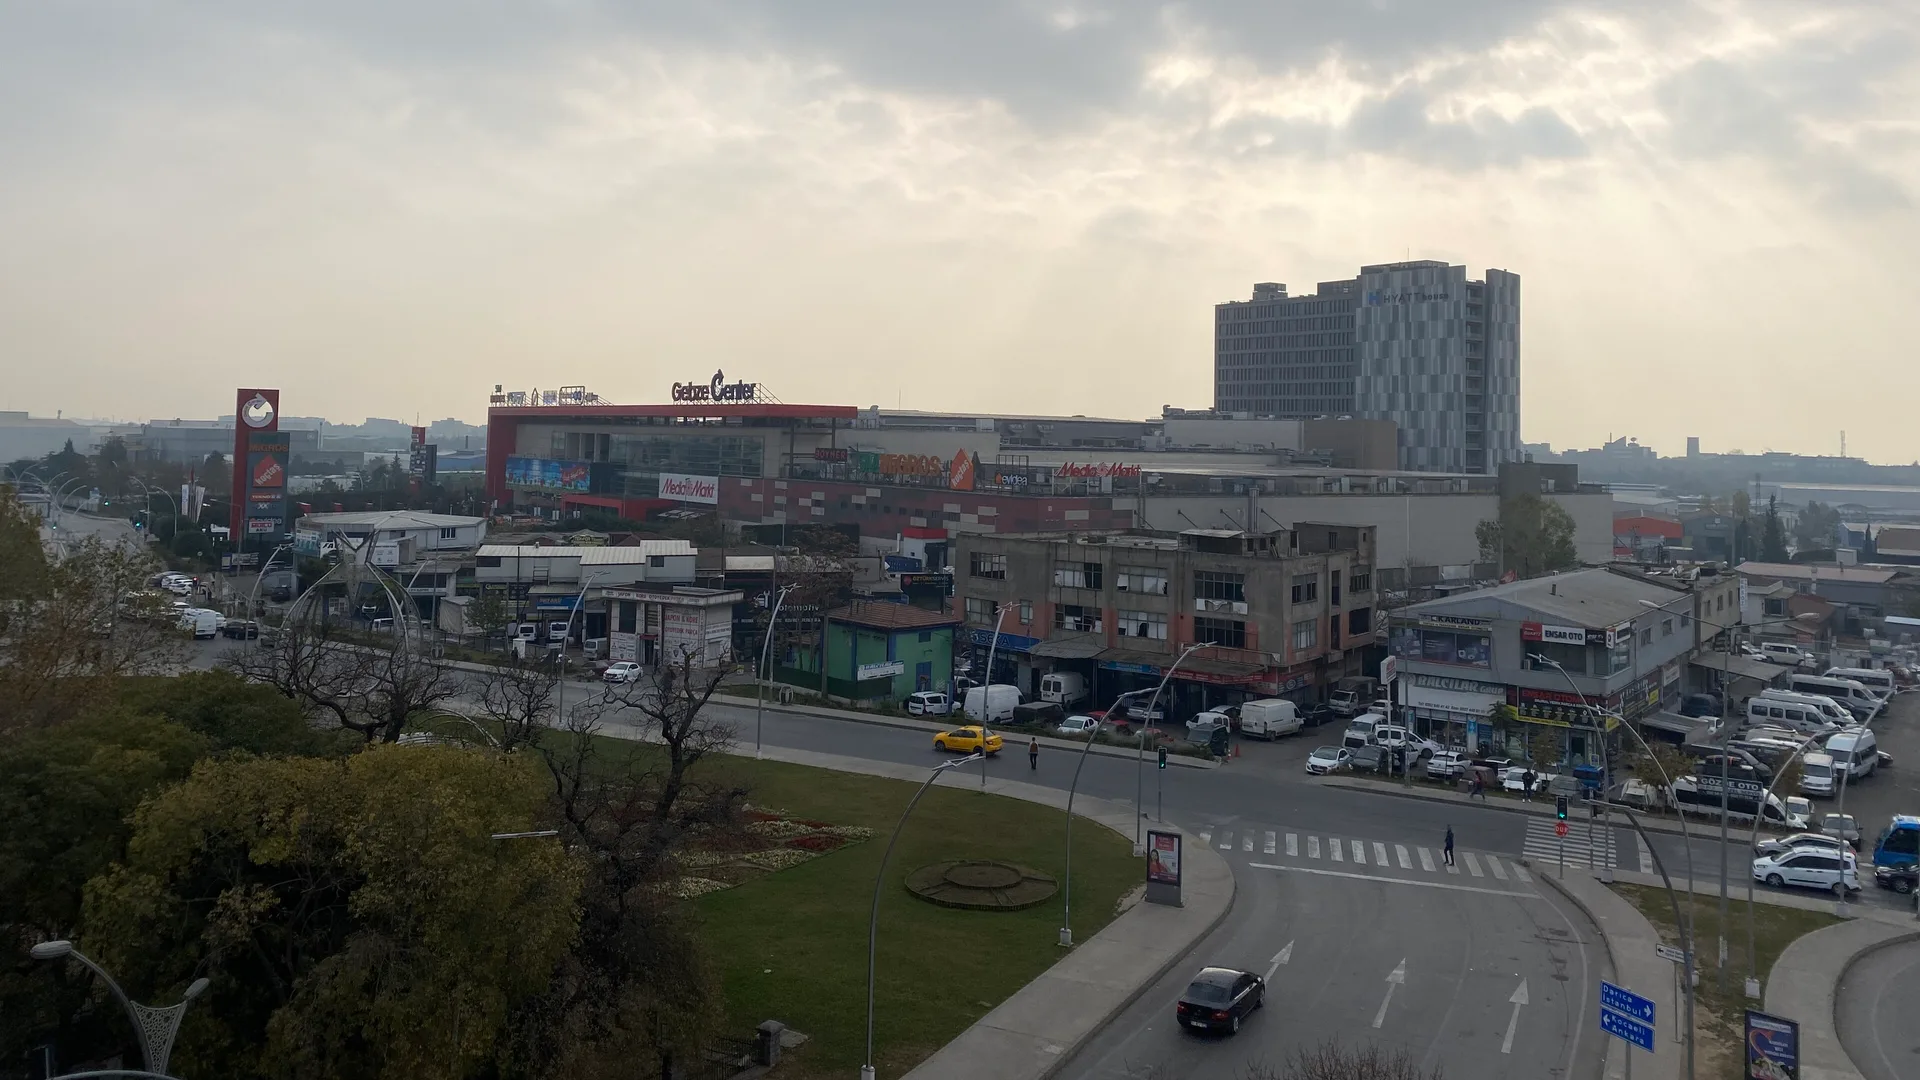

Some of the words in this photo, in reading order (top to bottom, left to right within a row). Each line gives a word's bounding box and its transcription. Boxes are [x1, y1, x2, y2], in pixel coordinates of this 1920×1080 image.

[1384, 293, 1421, 303] HYATT
[672, 381, 709, 401] Gebze
[711, 369, 756, 401] Center
[1055, 462, 1098, 477] Media
[1002, 473, 1027, 486] evidea
[1545, 629, 1567, 639] ENSAR
[1568, 632, 1583, 641] OTO
[1701, 778, 1735, 788] GÖZE
[1738, 782, 1759, 791] OTO
[1611, 1015, 1645, 1036] Kocaeli
[1611, 1024, 1645, 1045] Ankara
